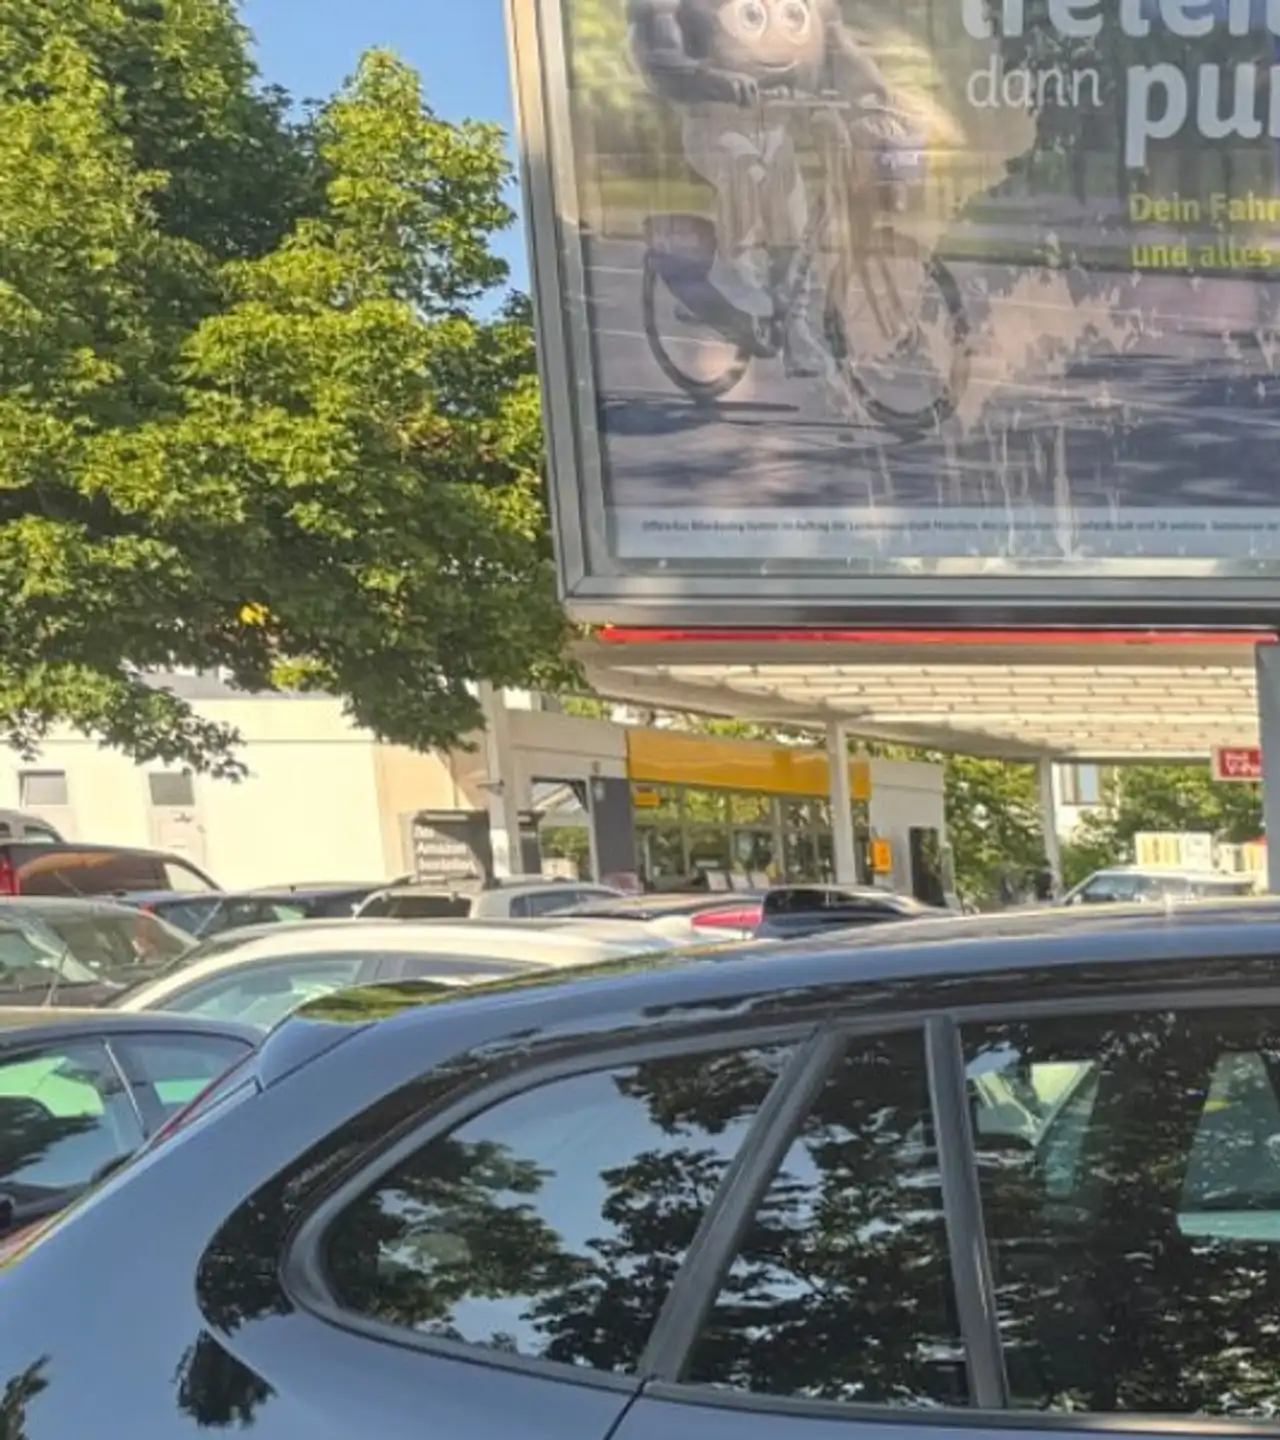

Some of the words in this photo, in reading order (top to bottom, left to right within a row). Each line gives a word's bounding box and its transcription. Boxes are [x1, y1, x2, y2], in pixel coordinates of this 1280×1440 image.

[967, 54, 1104, 108] dann
[1129, 191, 1200, 222] Dein
[1132, 236, 1188, 267] und
